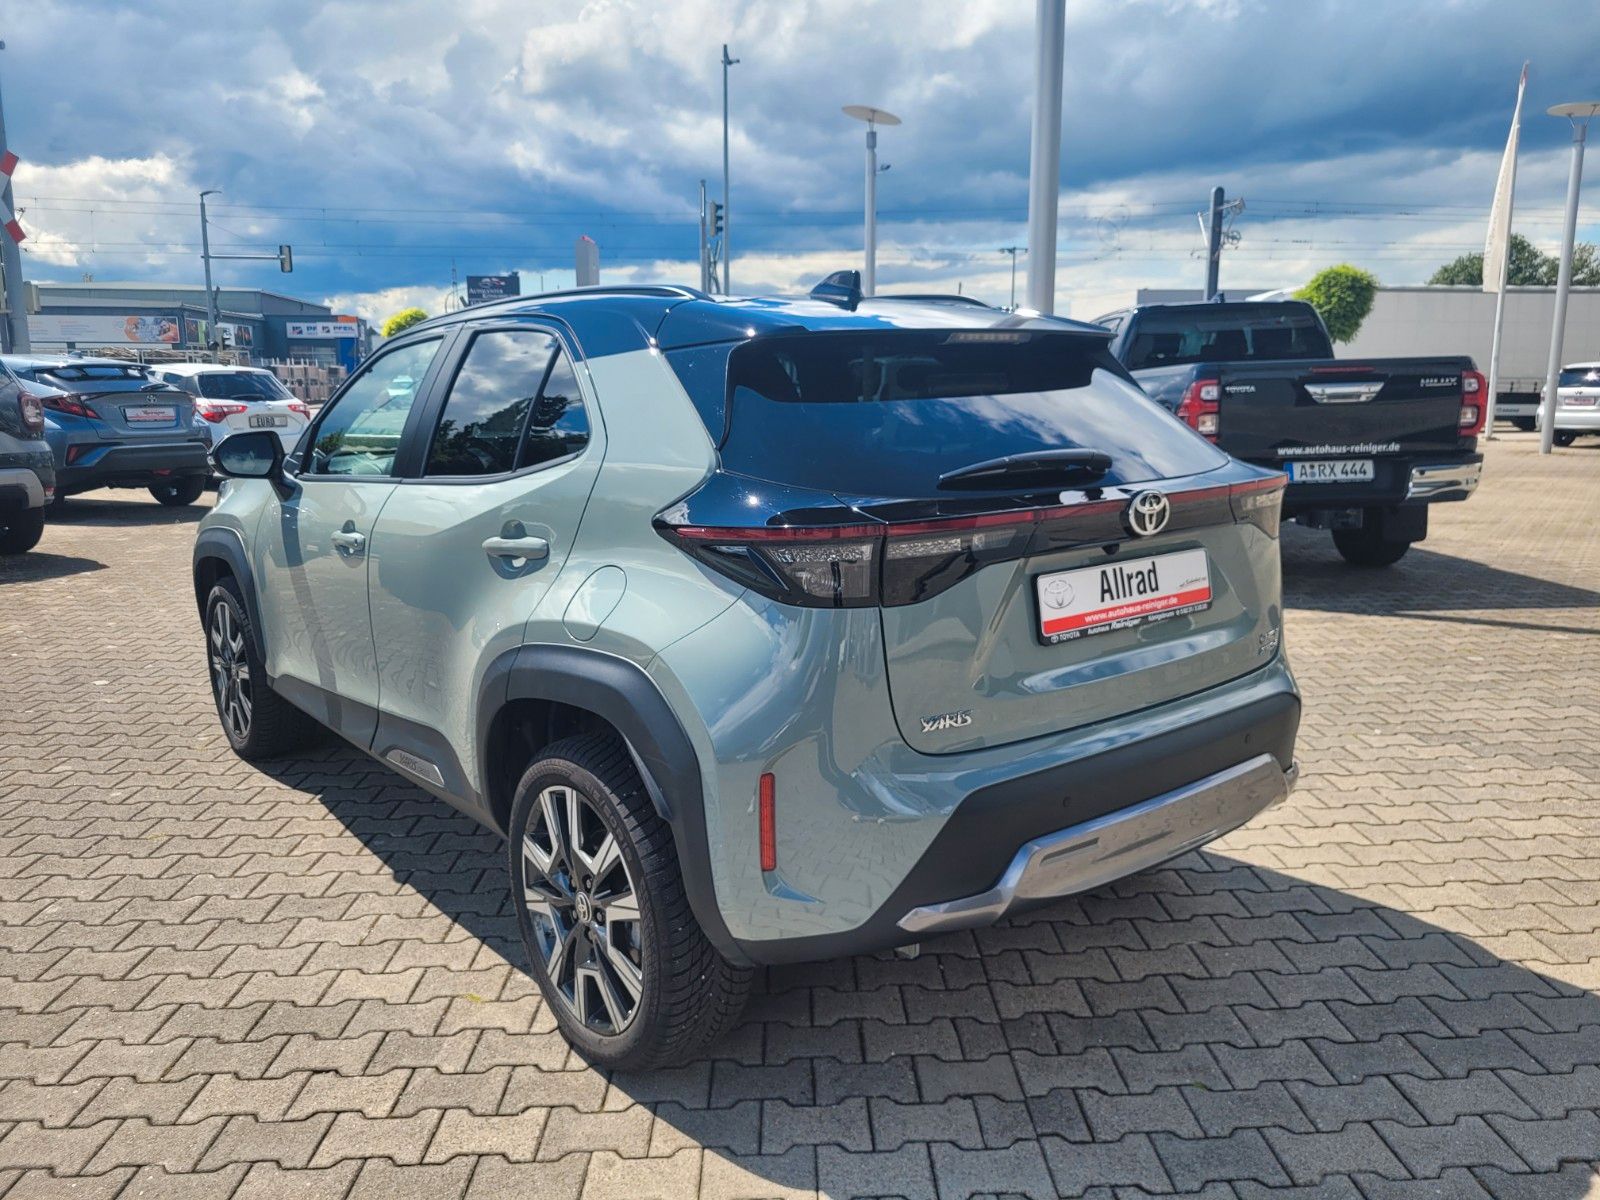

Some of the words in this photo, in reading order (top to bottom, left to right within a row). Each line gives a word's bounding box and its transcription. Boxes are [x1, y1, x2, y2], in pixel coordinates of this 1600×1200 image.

[1224, 385, 1256, 394] TOYOTA
[1277, 442, 1400, 455] www.autohaus-reiniger.de
[1341, 462, 1367, 477] 444
[1100, 561, 1159, 603] Allrad
[1084, 597, 1179, 624] www.autohaus-reiniger.de
[1059, 631, 1080, 641] TOYOTA
[1110, 618, 1142, 631] Reiniger
[920, 711, 972, 733] YARIS
